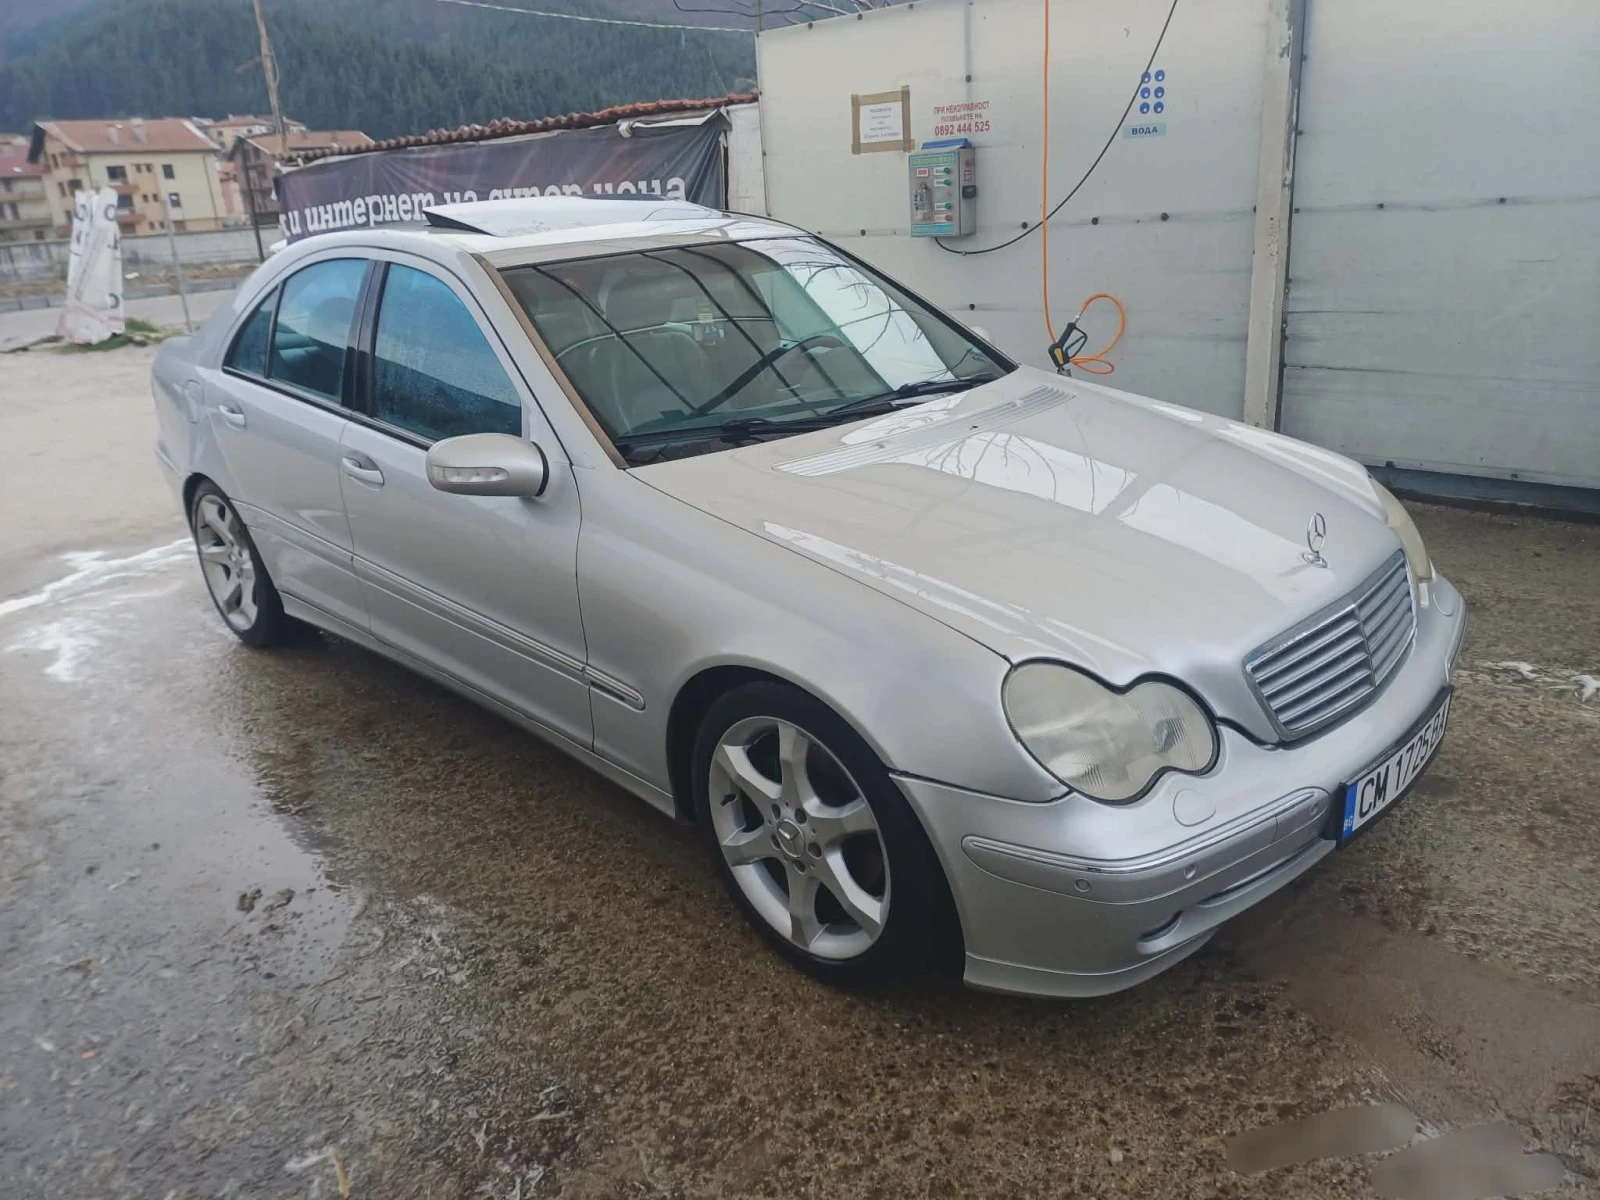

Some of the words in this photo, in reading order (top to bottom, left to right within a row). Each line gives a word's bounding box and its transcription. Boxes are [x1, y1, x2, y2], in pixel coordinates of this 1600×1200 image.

[934, 124, 955, 136] 0892
[956, 122, 972, 134] 444
[974, 120, 991, 132] 525
[1131, 126, 1158, 136] ВОДА
[304, 192, 435, 232] интернет
[1358, 765, 1390, 819] CM
[1395, 722, 1432, 792] 1725
